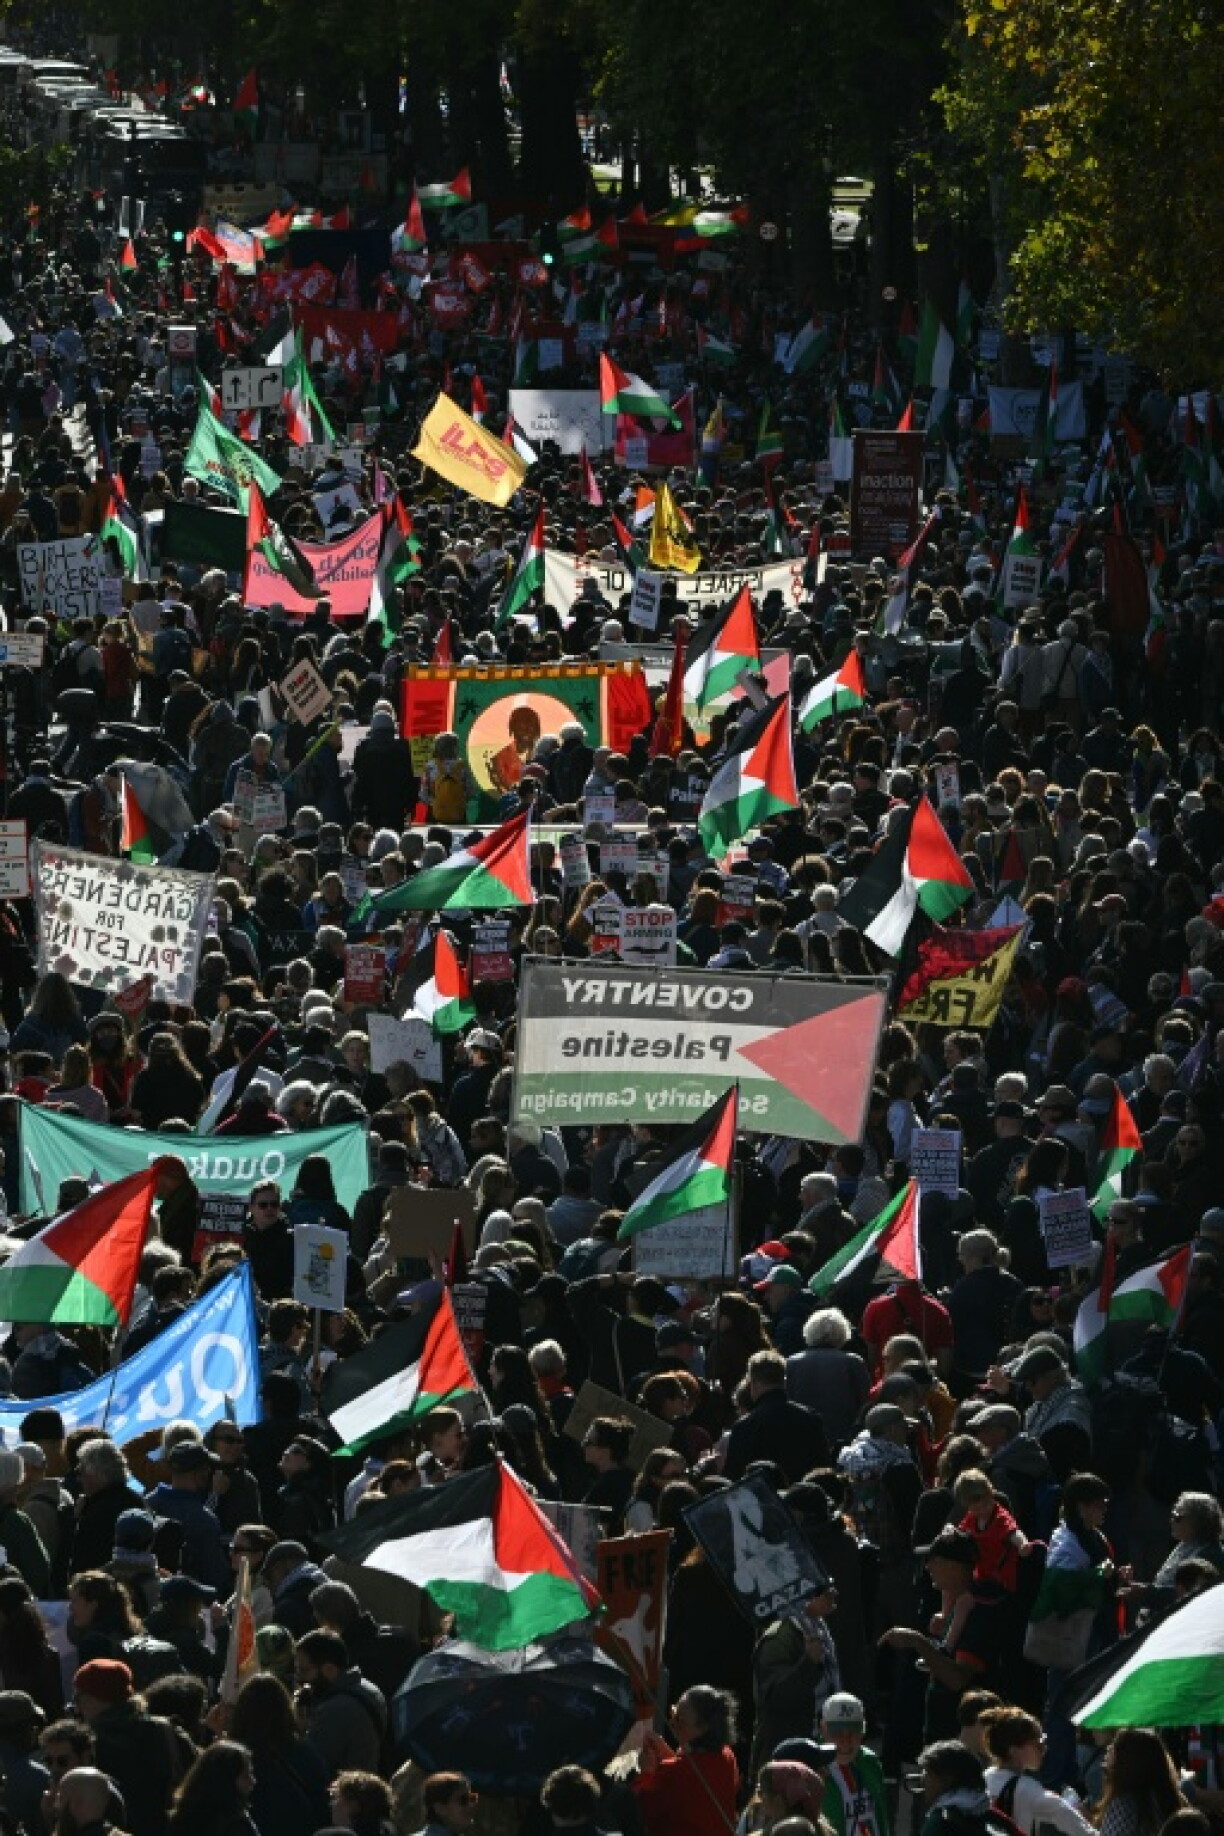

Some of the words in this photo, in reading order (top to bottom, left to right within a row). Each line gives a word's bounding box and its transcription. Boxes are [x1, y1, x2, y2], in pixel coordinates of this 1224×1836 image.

[860, 471, 914, 489] inaction
[625, 912, 673, 926] STOP
[753, 1577, 817, 1618] GAZA
